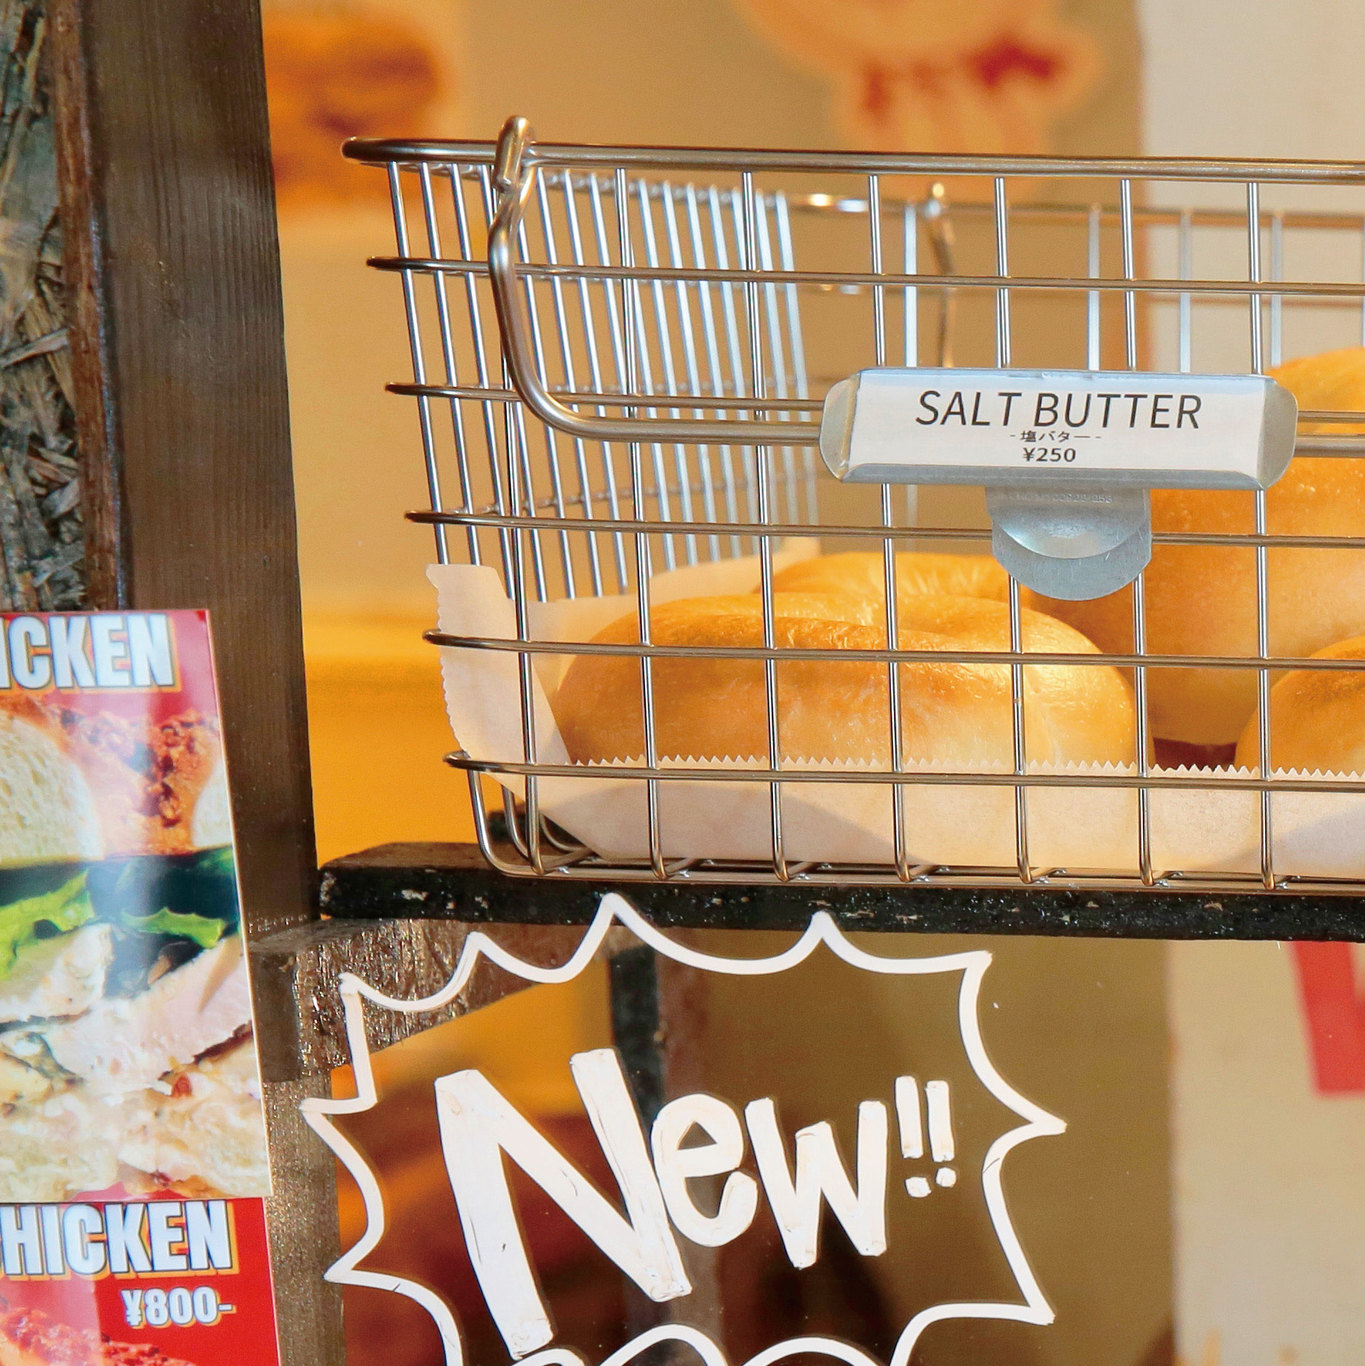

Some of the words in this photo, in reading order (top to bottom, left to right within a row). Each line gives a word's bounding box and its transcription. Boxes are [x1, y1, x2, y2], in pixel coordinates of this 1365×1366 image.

[914, 389, 1022, 428] SALT
[1033, 391, 1203, 430] BUTTER
[1022, 446, 1077, 464] ¥250
[121, 1286, 233, 1327] ¥800-
